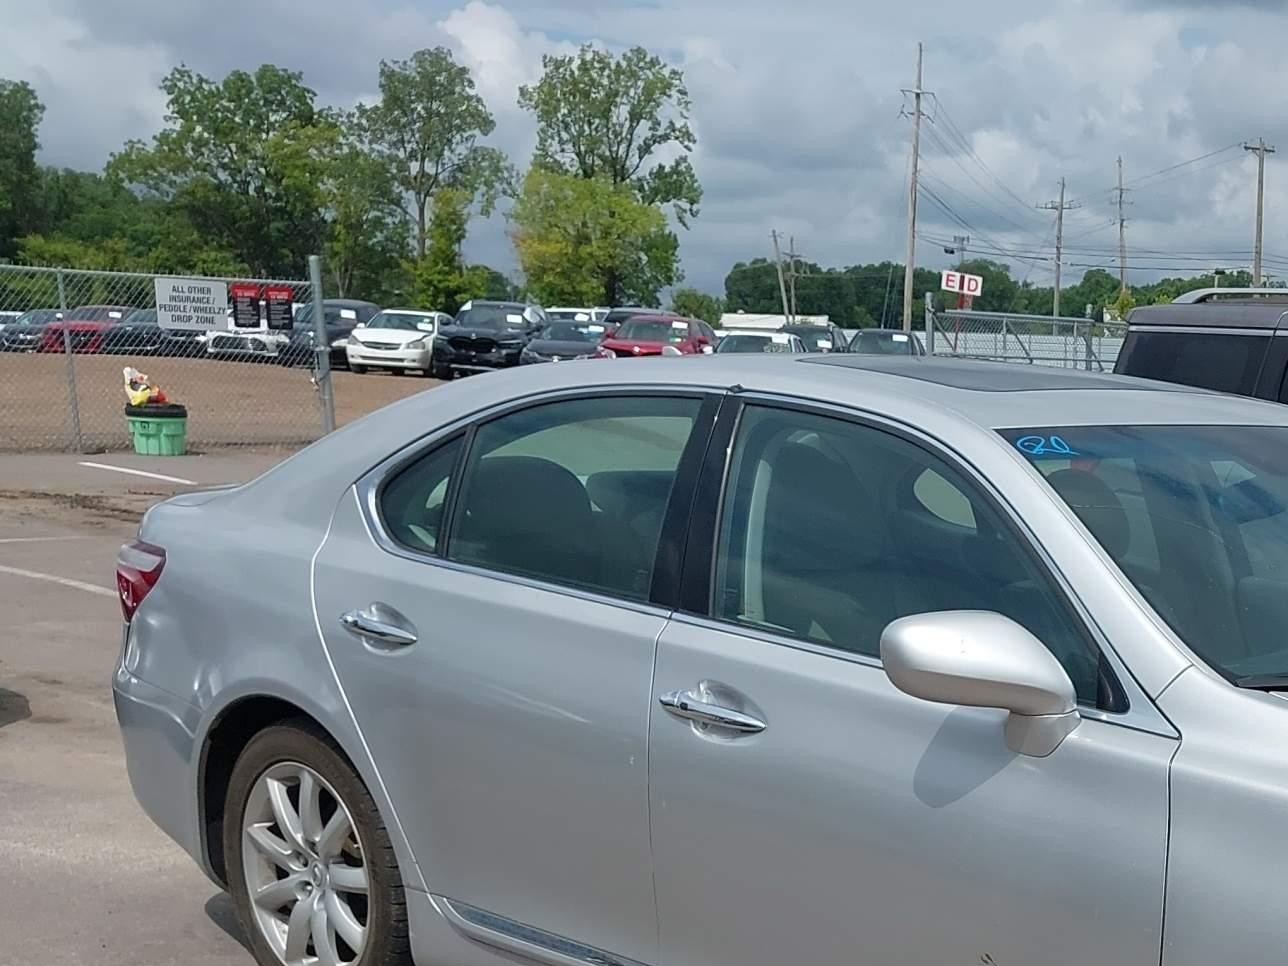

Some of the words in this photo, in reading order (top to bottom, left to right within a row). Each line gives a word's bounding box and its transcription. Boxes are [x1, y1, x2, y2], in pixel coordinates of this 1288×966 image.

[172, 285, 186, 294] ALL
[187, 286, 211, 296] OTHER
[171, 314, 193, 323] DROP
[195, 315, 216, 325] ZONE
